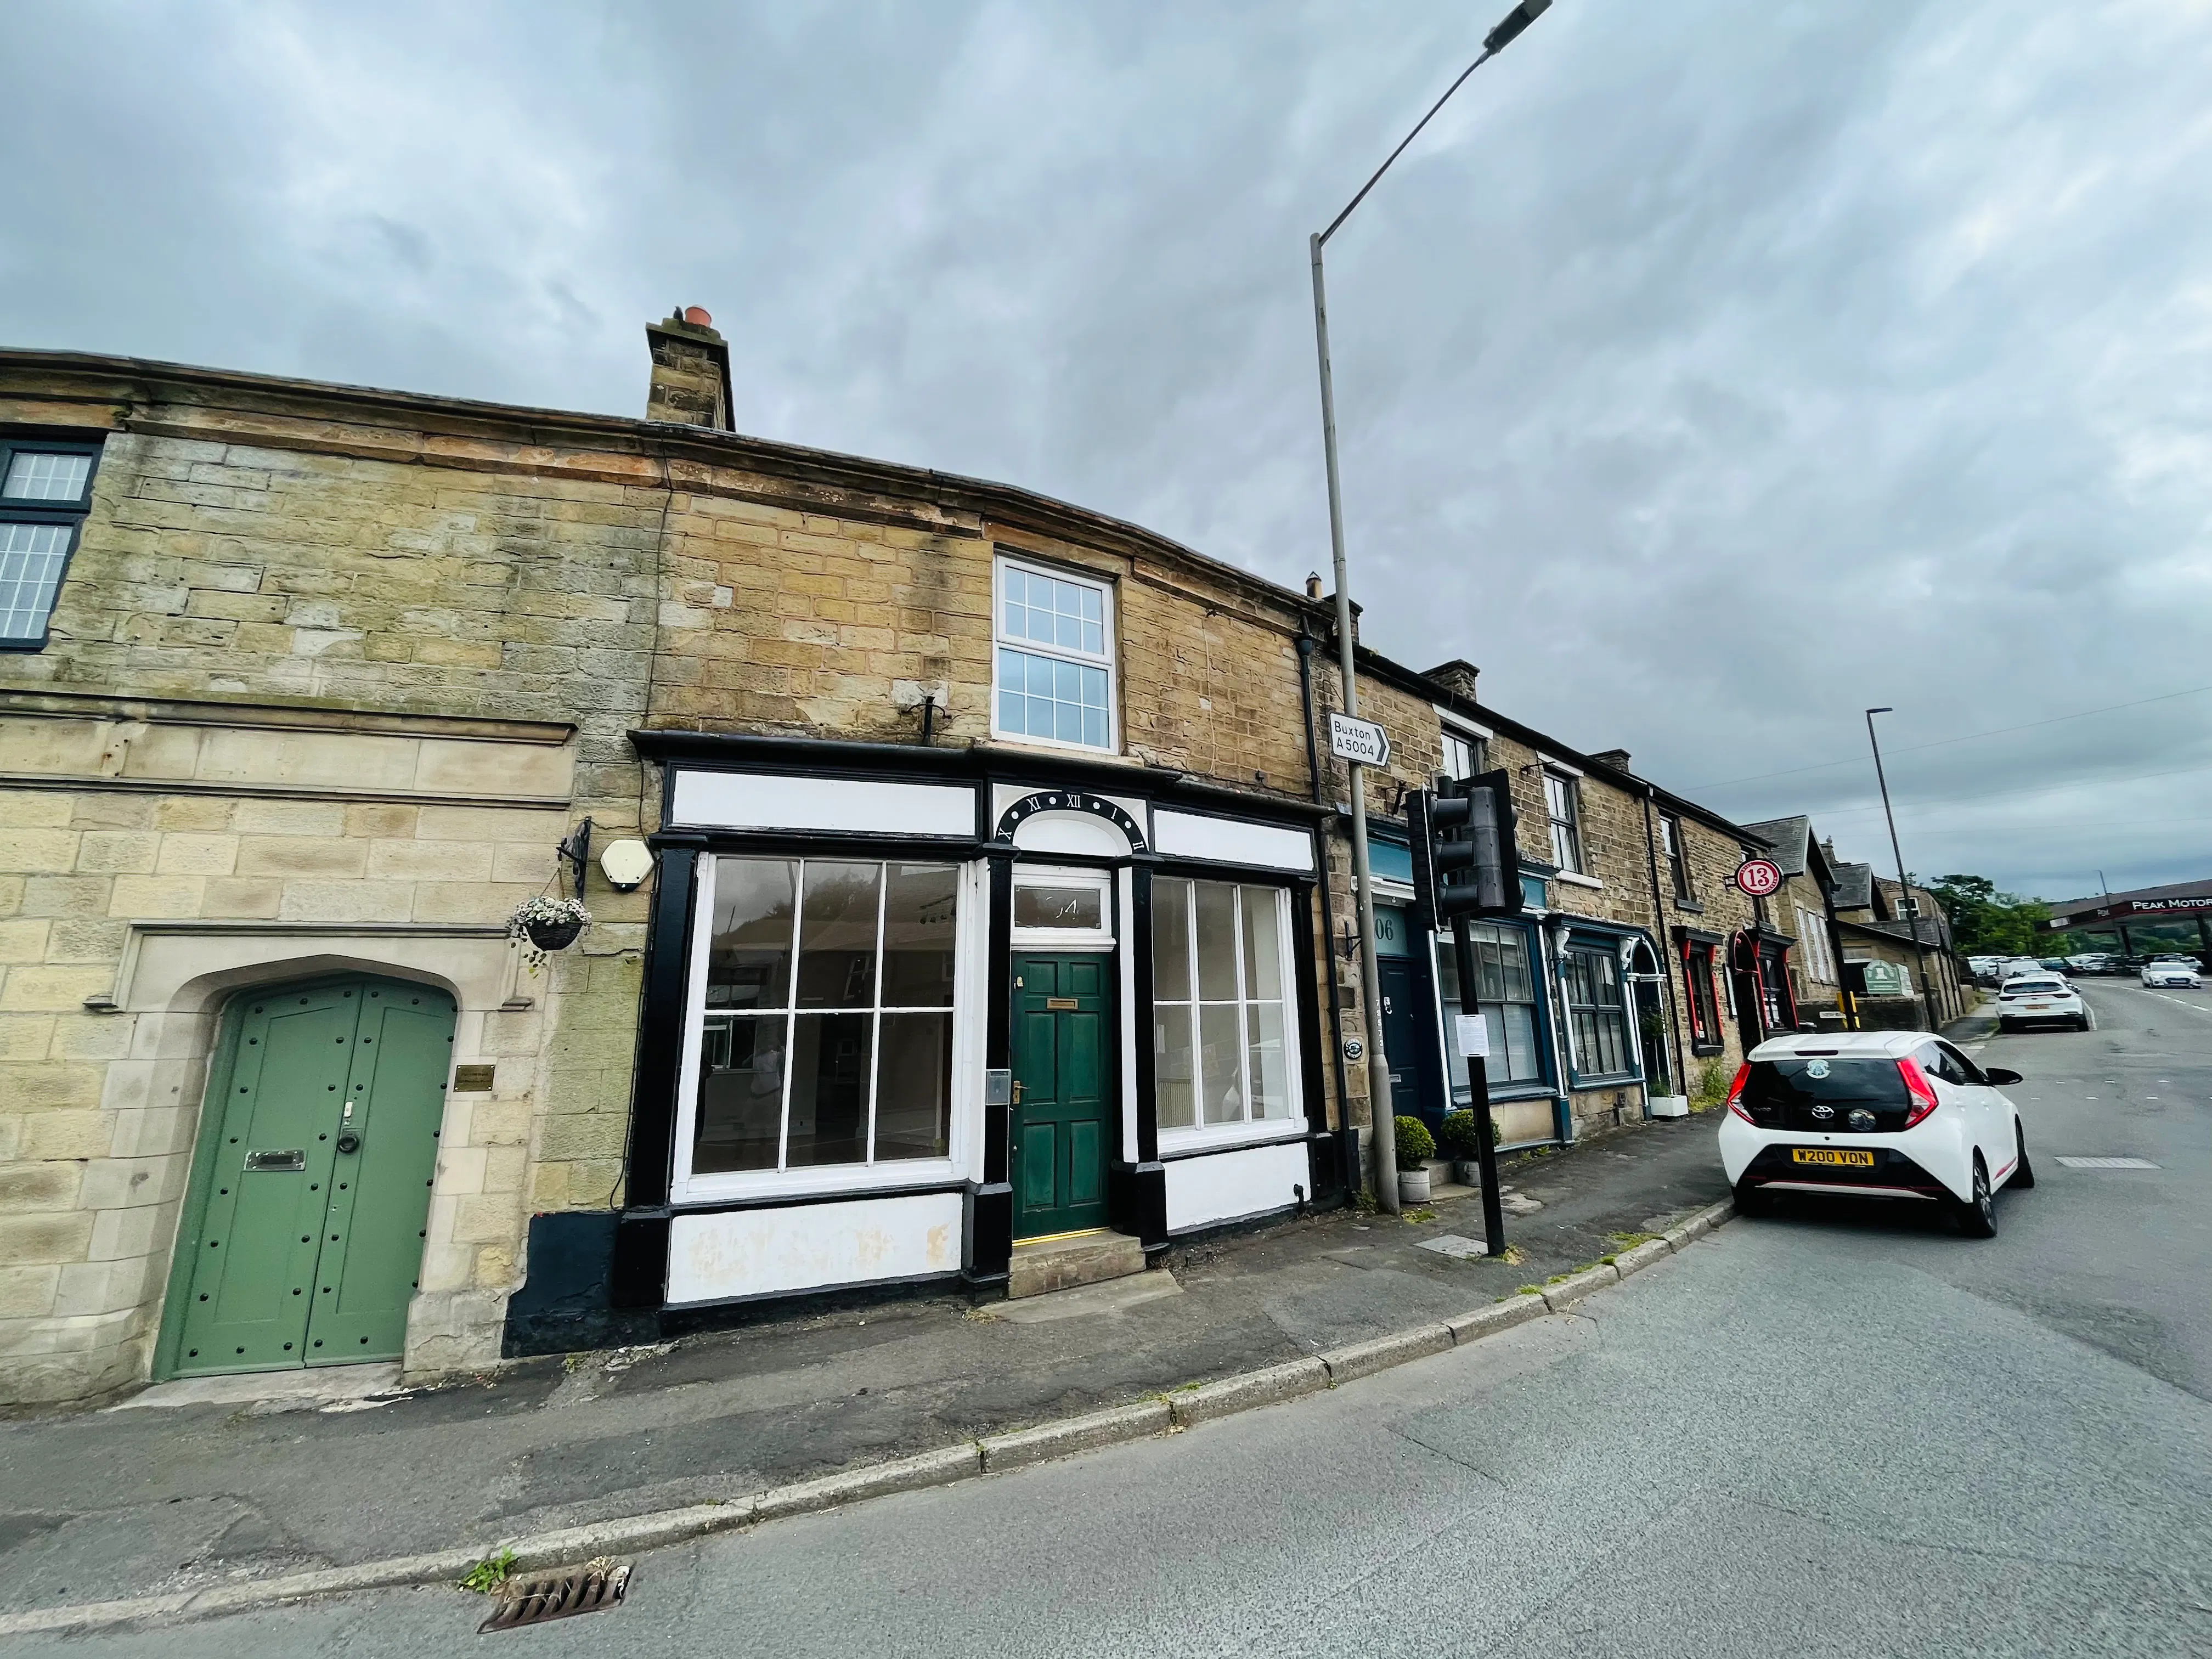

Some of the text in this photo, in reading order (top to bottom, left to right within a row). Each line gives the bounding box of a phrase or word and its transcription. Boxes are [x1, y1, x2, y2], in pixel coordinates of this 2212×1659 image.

[1334, 720, 1370, 741] Buxton
[1026, 796, 1041, 812] XI
[1066, 794, 1081, 808] XII
[1747, 867, 1770, 887] 13
[2132, 901, 2165, 910] PEAK
[1798, 1150, 1869, 1164] W200 VON
